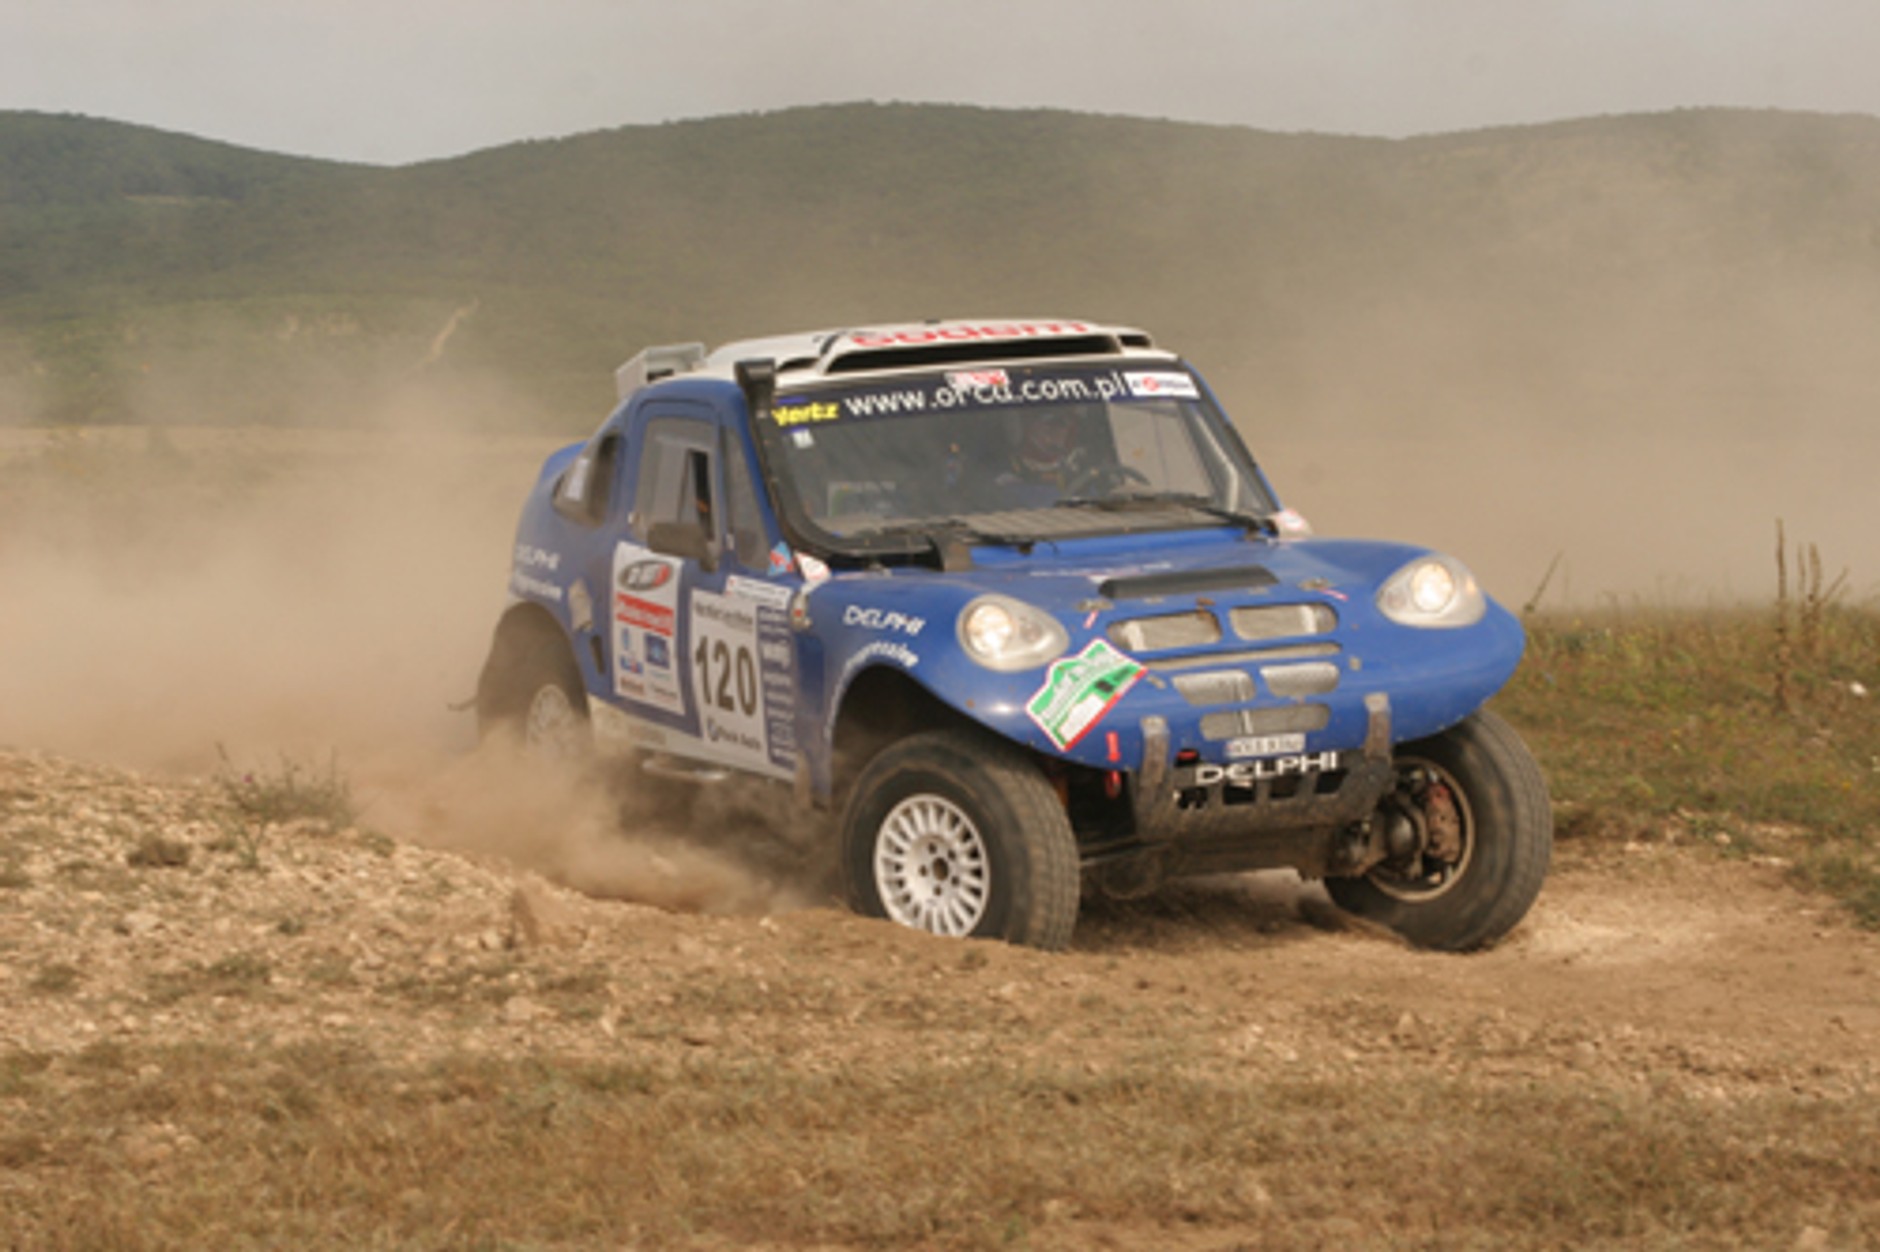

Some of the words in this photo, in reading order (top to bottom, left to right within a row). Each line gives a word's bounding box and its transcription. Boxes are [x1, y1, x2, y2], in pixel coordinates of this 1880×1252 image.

[843, 604, 927, 637] DELPHI
[695, 635, 758, 717] 120
[1195, 751, 1337, 786] DELPHI
